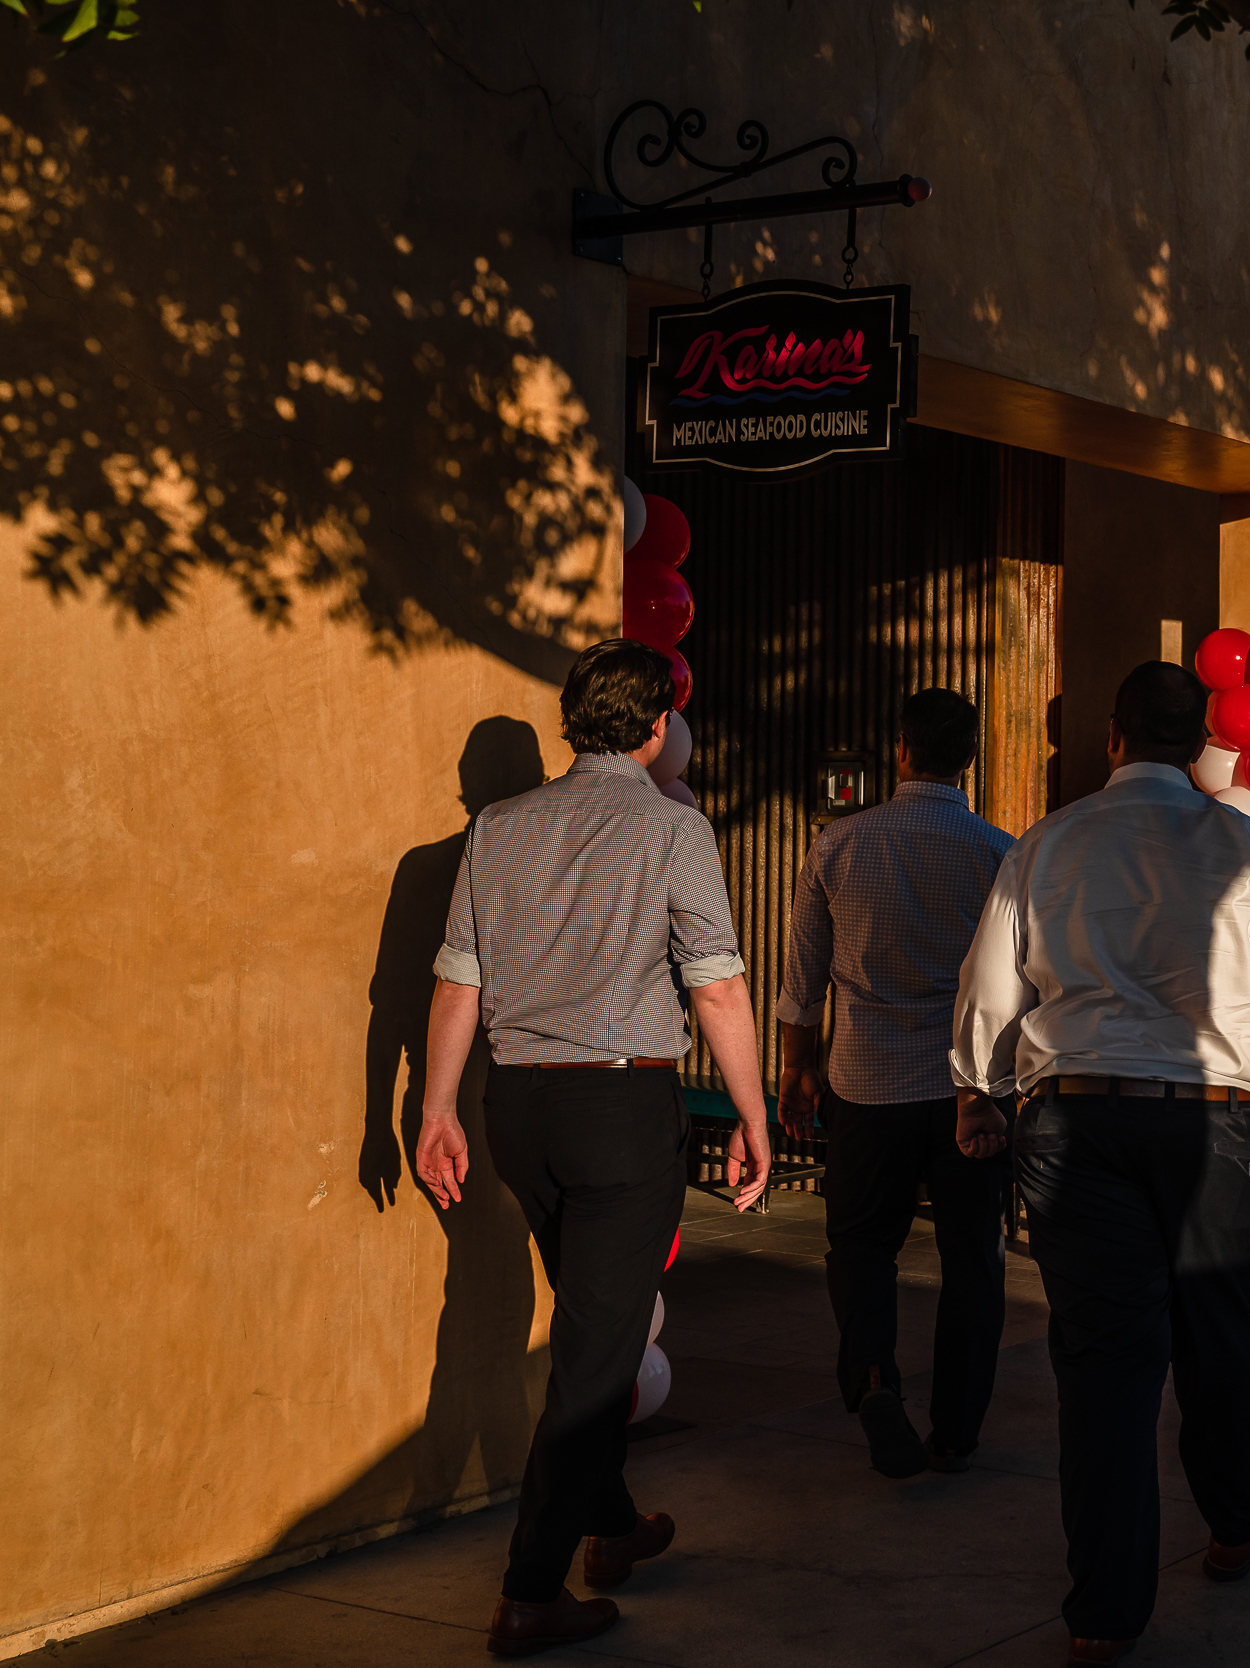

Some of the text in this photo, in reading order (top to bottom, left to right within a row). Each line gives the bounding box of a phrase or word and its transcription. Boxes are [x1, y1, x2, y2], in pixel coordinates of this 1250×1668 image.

[674, 324, 872, 398] Karina's
[672, 410, 868, 446] MEXICAN SEAFOOD CUISINE
